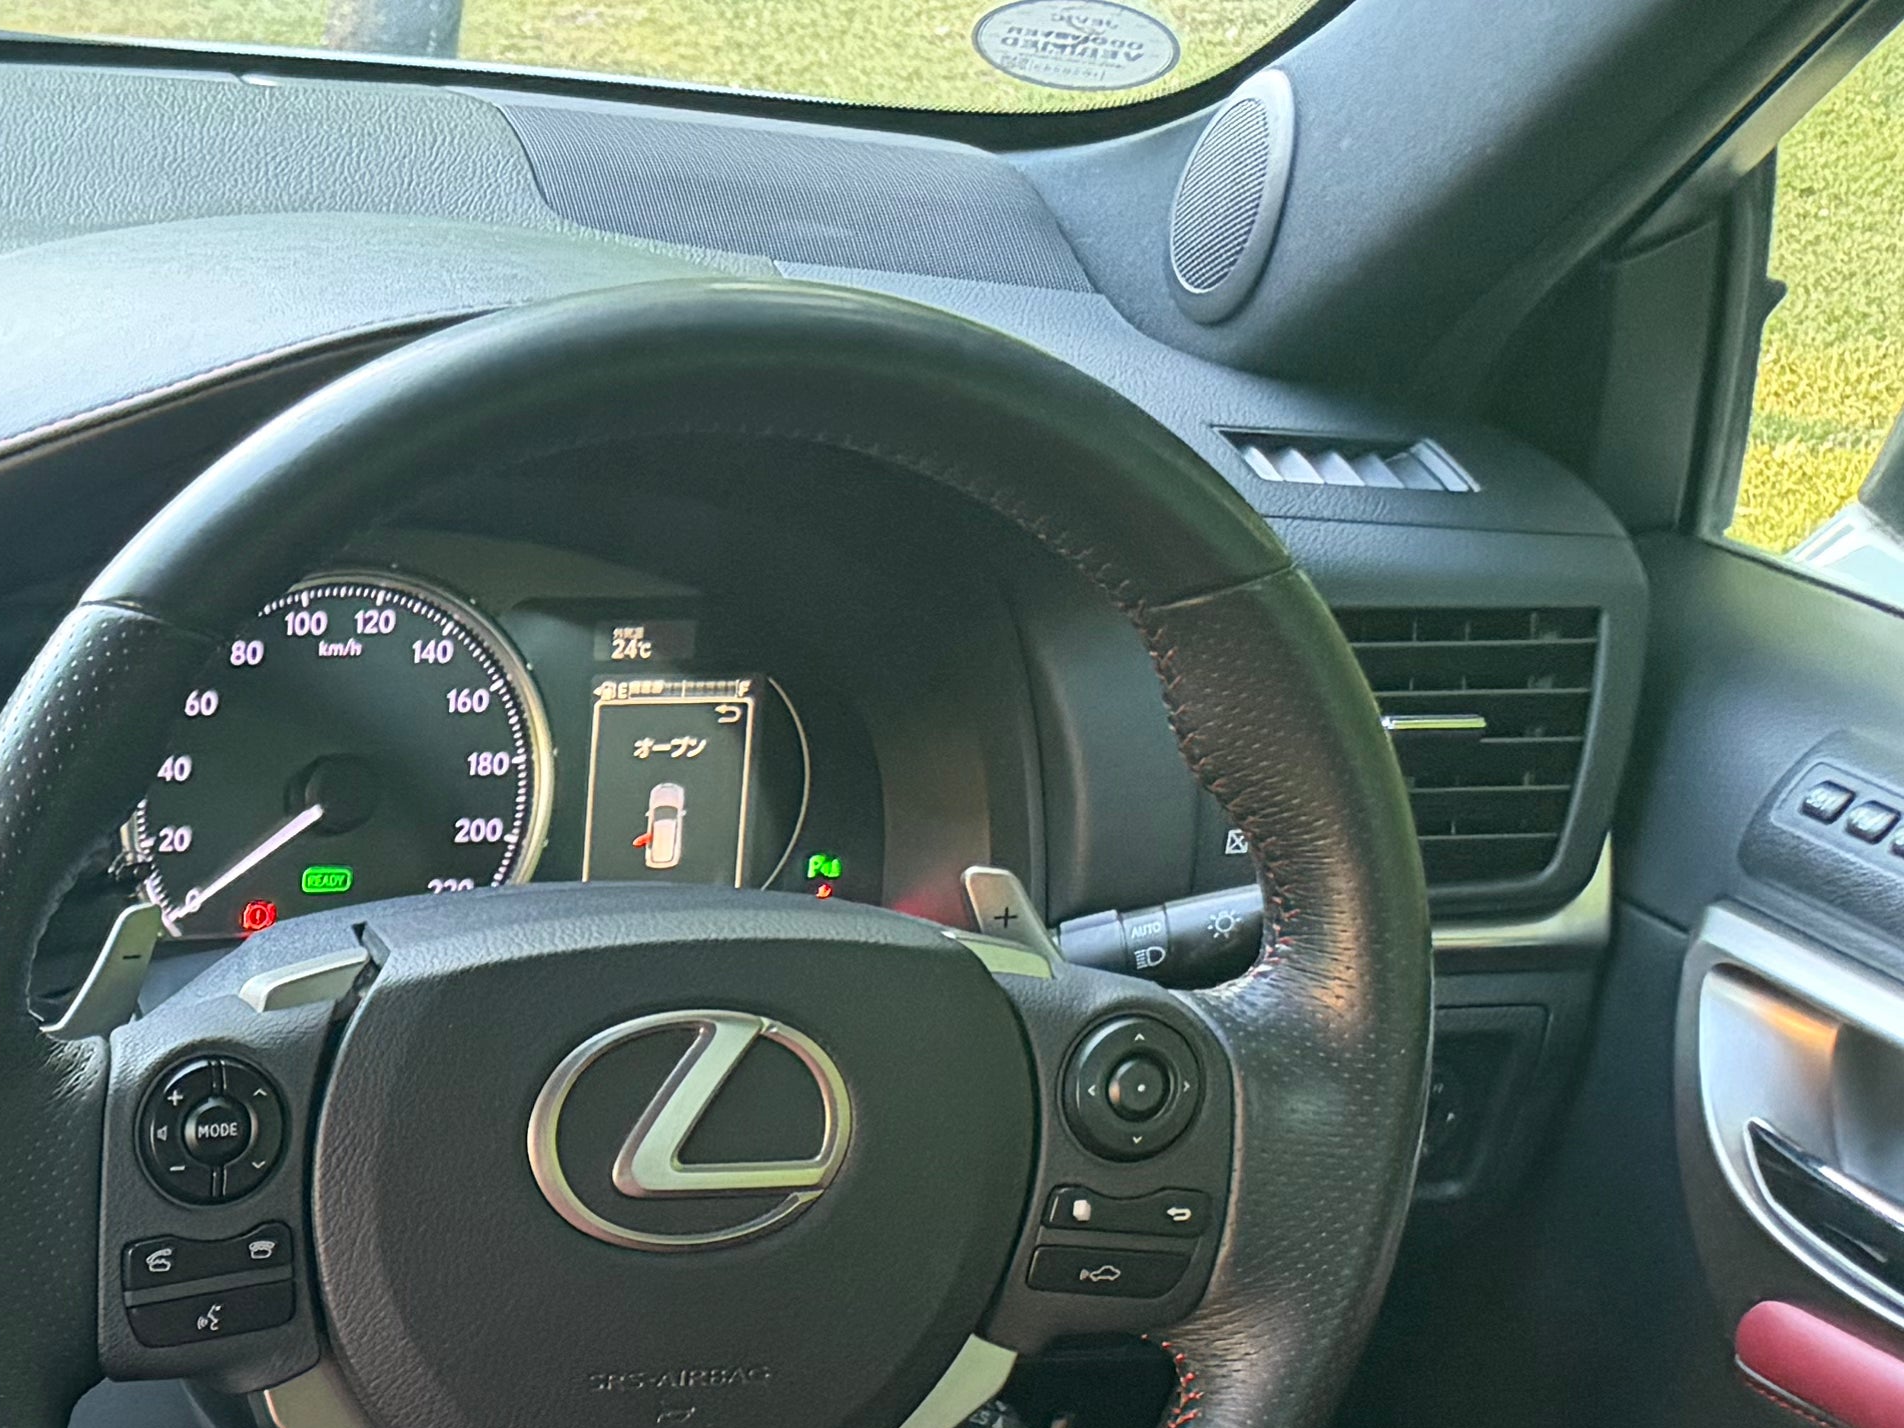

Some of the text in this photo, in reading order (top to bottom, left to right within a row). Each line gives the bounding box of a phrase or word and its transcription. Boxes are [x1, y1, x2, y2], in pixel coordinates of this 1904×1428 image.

[284, 610, 328, 636] 100
[355, 609, 396, 635] 120
[230, 640, 265, 666] 80
[319, 640, 363, 657] km/h
[412, 639, 454, 664] 140
[184, 690, 219, 717] 60
[447, 688, 490, 714] 160
[633, 736, 707, 758] オープン
[157, 755, 192, 782] 40
[467, 751, 510, 777] 180
[158, 826, 192, 853] 20
[454, 817, 503, 844] 200
[307, 874, 347, 888] READY
[1130, 919, 1162, 940] AUTO
[197, 1121, 239, 1139] MODE
